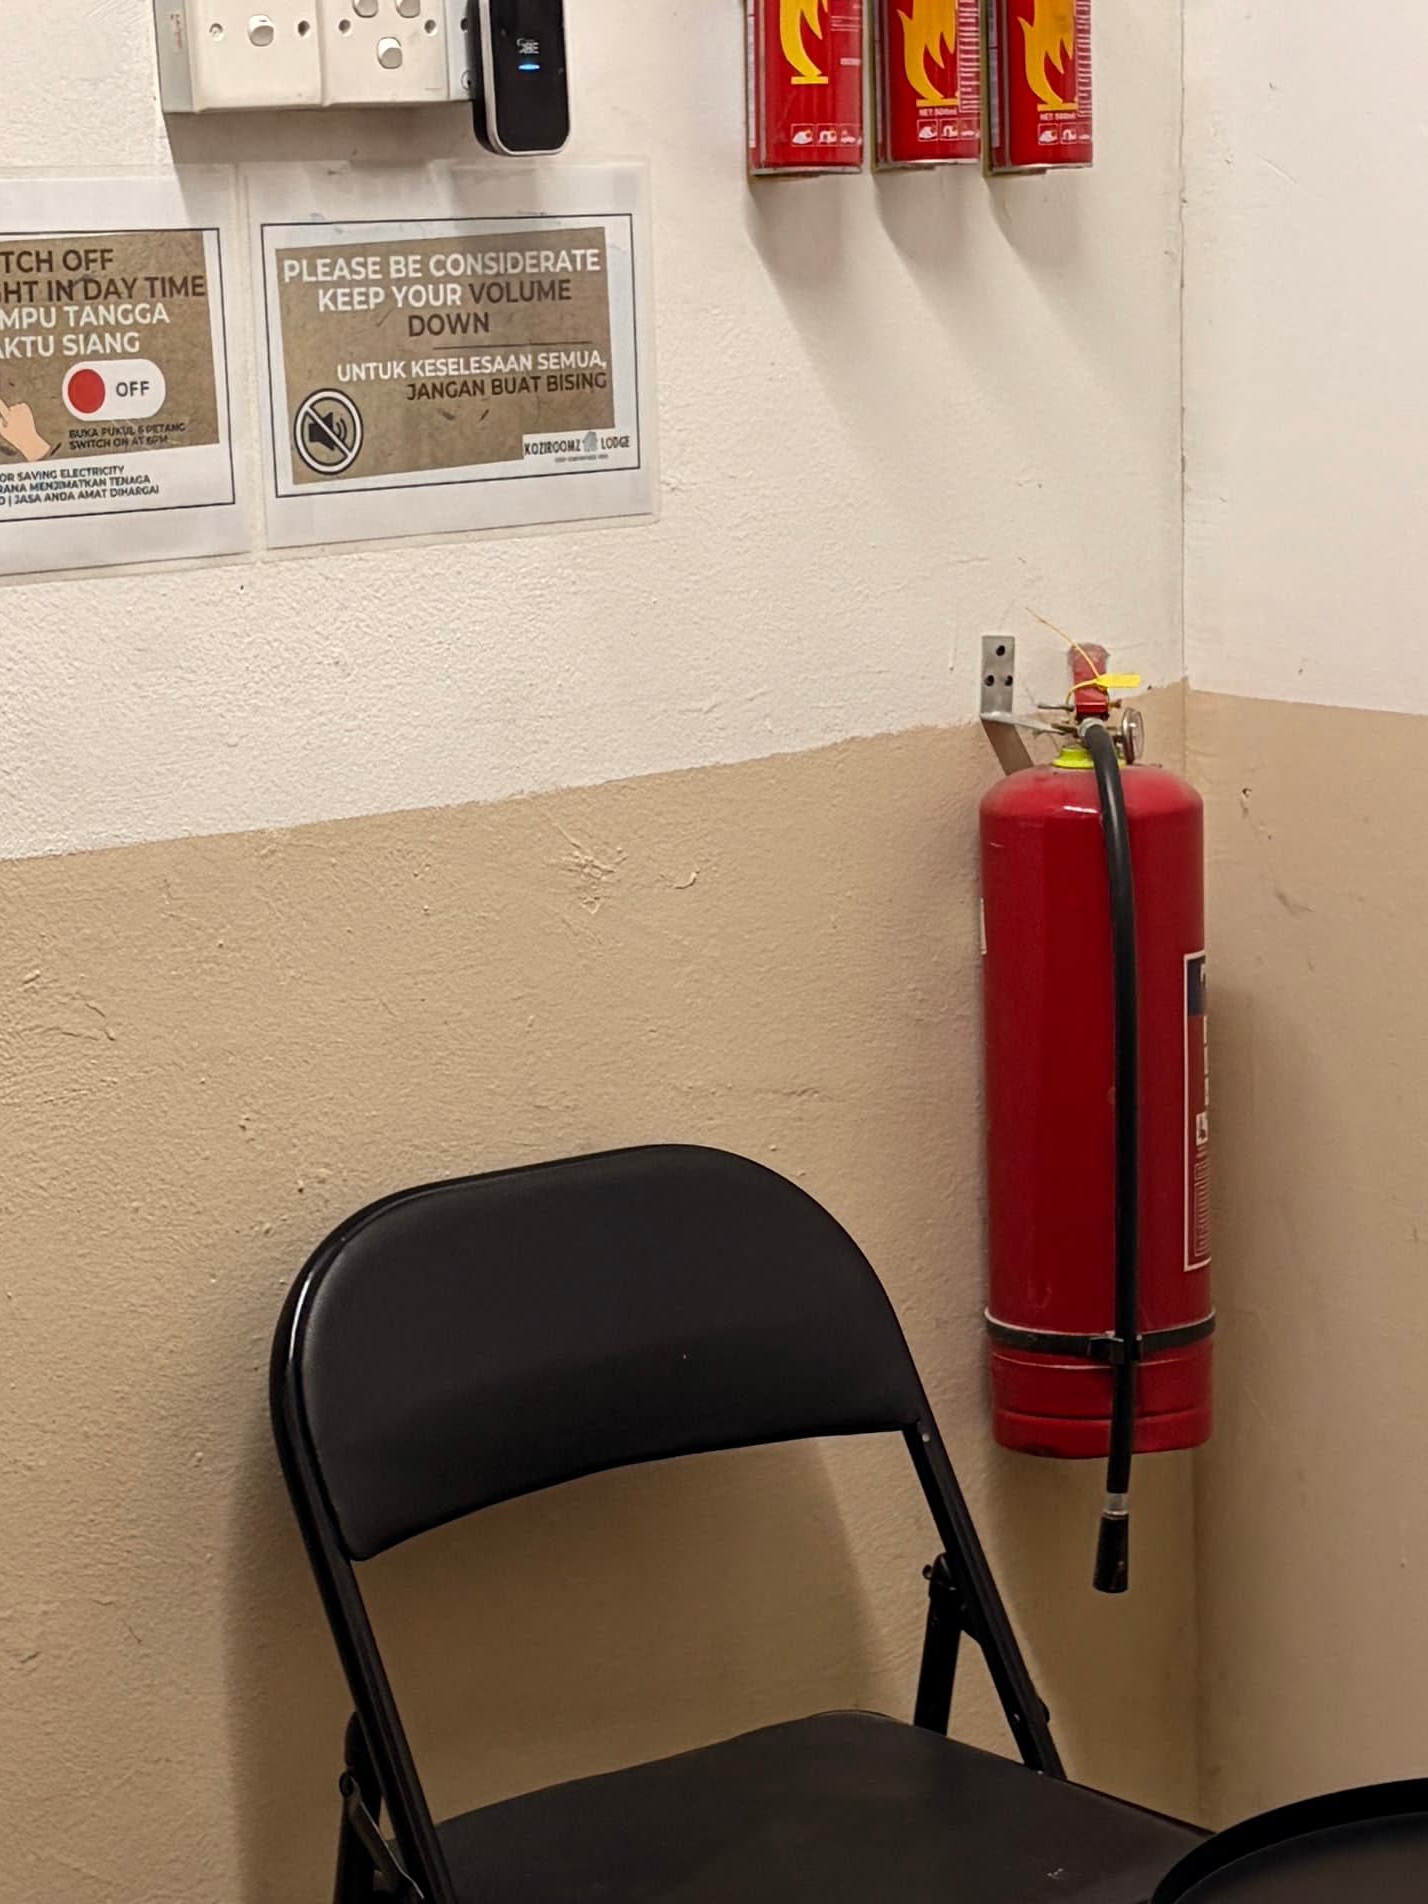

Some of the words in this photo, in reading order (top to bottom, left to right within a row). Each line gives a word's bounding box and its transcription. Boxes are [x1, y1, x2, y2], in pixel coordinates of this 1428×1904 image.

[62, 248, 114, 272] OFF
[283, 256, 383, 283] PLEASE
[389, 254, 422, 278] BE
[428, 248, 601, 277] CONSIDERATE
[47, 279, 72, 301] IN
[83, 277, 139, 301] DAY
[144, 275, 206, 297] TIME
[318, 287, 384, 312] KEEP
[391, 283, 462, 308] YOUR
[468, 279, 572, 305] VOLUME
[63, 302, 170, 327] TANGGA
[408, 312, 490, 338] DOWN
[62, 331, 141, 356] SIANG
[337, 361, 406, 382] UNTUK
[411, 354, 533, 378] KESELESAAN
[537, 349, 607, 371] SEMUA,
[116, 380, 151, 398] OFF
[406, 380, 486, 401] JANGAN
[491, 376, 541, 396] BUAT
[547, 371, 607, 392] BISING
[69, 428, 98, 439] BUKA
[146, 423, 186, 434] PETANG
[69, 439, 111, 450] SWITCH
[113, 437, 128, 448] ON
[132, 436, 144, 446] AT
[17, 470, 57, 481] SAVING
[60, 465, 124, 478] ELECTRICITY
[29, 477, 107, 491] MENJIMATKAN
[109, 475, 150, 486] TENAGA
[15, 494, 42, 505] JASA
[44, 492, 75, 503] ANDA
[78, 489, 106, 499] AMAT
[110, 485, 160, 497] DIHARGAI
